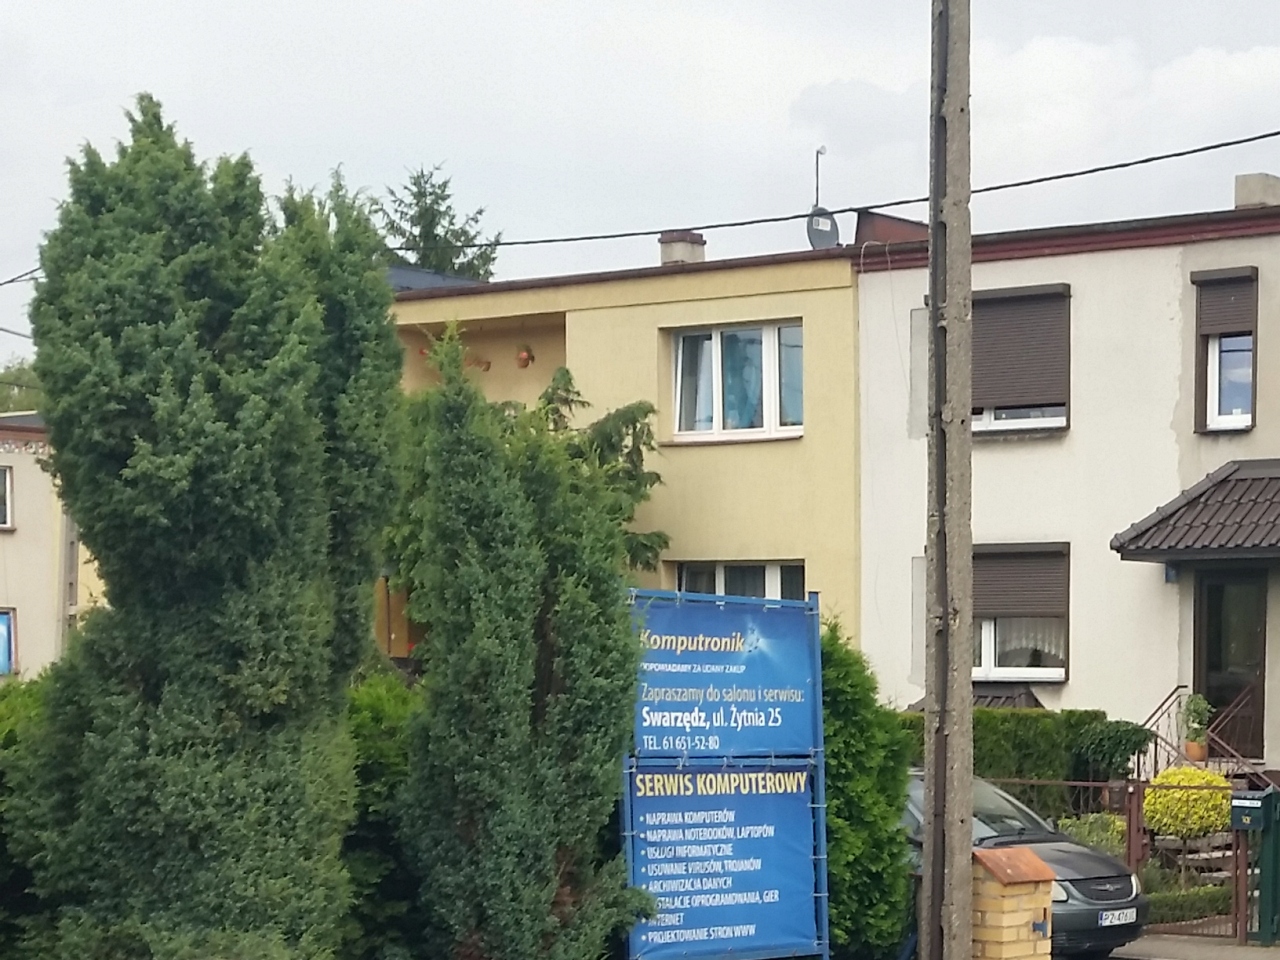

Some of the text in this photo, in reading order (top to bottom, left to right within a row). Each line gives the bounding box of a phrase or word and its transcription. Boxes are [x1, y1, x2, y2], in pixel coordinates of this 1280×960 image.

[640, 629, 744, 655] Komputronik
[692, 664, 701, 673] ZA
[725, 665, 746, 674] ZAKUP
[642, 682, 804, 705] Zapraszamy do salonu i serwisu:
[642, 704, 782, 732] Swarzędz, ul. Żytnia 25
[643, 735, 661, 750] TEL.
[662, 736, 674, 750] 61
[636, 771, 807, 797] SERWIS KOMPUTEROWY
[646, 807, 735, 825] NAPRAWA KOMPUTERÓW
[646, 829, 684, 842] NAPRAWA
[736, 823, 775, 838] LAPTOPÓW
[647, 843, 733, 859] USŁUGI INFORMATYCZNE
[647, 862, 687, 876] USUWANIE
[724, 857, 762, 871] TROJANÓW
[648, 876, 733, 893] ARCHIWIZACJA DANYCH
[656, 895, 690, 909] STALACJE
[763, 889, 779, 903] GIER
[648, 924, 756, 944] PROJEKTOWANIE STRON WWW
